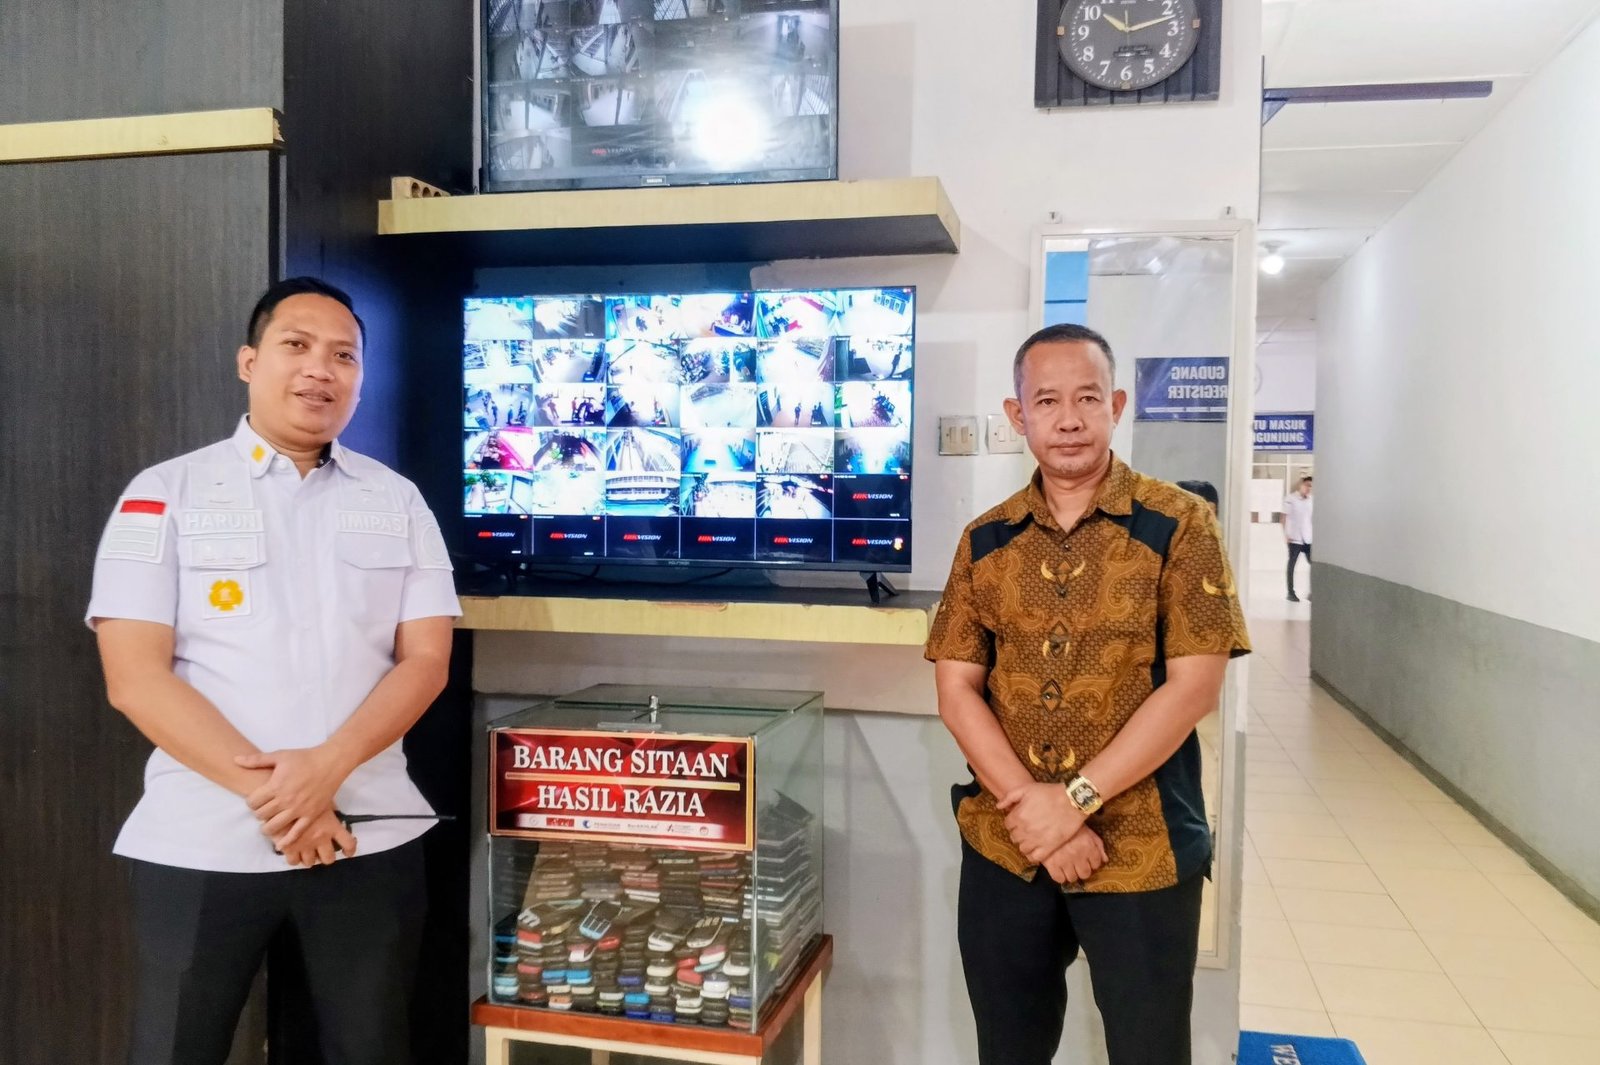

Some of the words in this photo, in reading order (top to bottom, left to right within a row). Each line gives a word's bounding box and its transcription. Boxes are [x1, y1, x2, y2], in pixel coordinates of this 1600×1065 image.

[1083, 5, 1101, 21] 10
[1161, 0, 1174, 15] 2
[1078, 25, 1090, 41] 9
[1167, 21, 1179, 36] 3
[1083, 46, 1095, 61] 8
[1159, 42, 1171, 58] 4
[1100, 60, 1111, 76] 7
[1120, 65, 1132, 81] 6
[1143, 58, 1155, 74] 5
[1269, 419, 1307, 430] MASUK
[852, 492, 894, 500] HIKVISION
[184, 511, 258, 530] HARUN
[550, 532, 588, 540] HIKVISION
[623, 533, 662, 541] HIKVISION
[697, 535, 737, 543] HIKVISION
[773, 536, 814, 544] HIKVISION
[851, 538, 893, 546] HIKVISION
[512, 745, 624, 774] BARANG
[630, 749, 729, 778] SITAAN
[536, 785, 617, 812] HASIL
[622, 789, 706, 817] RAZIA
